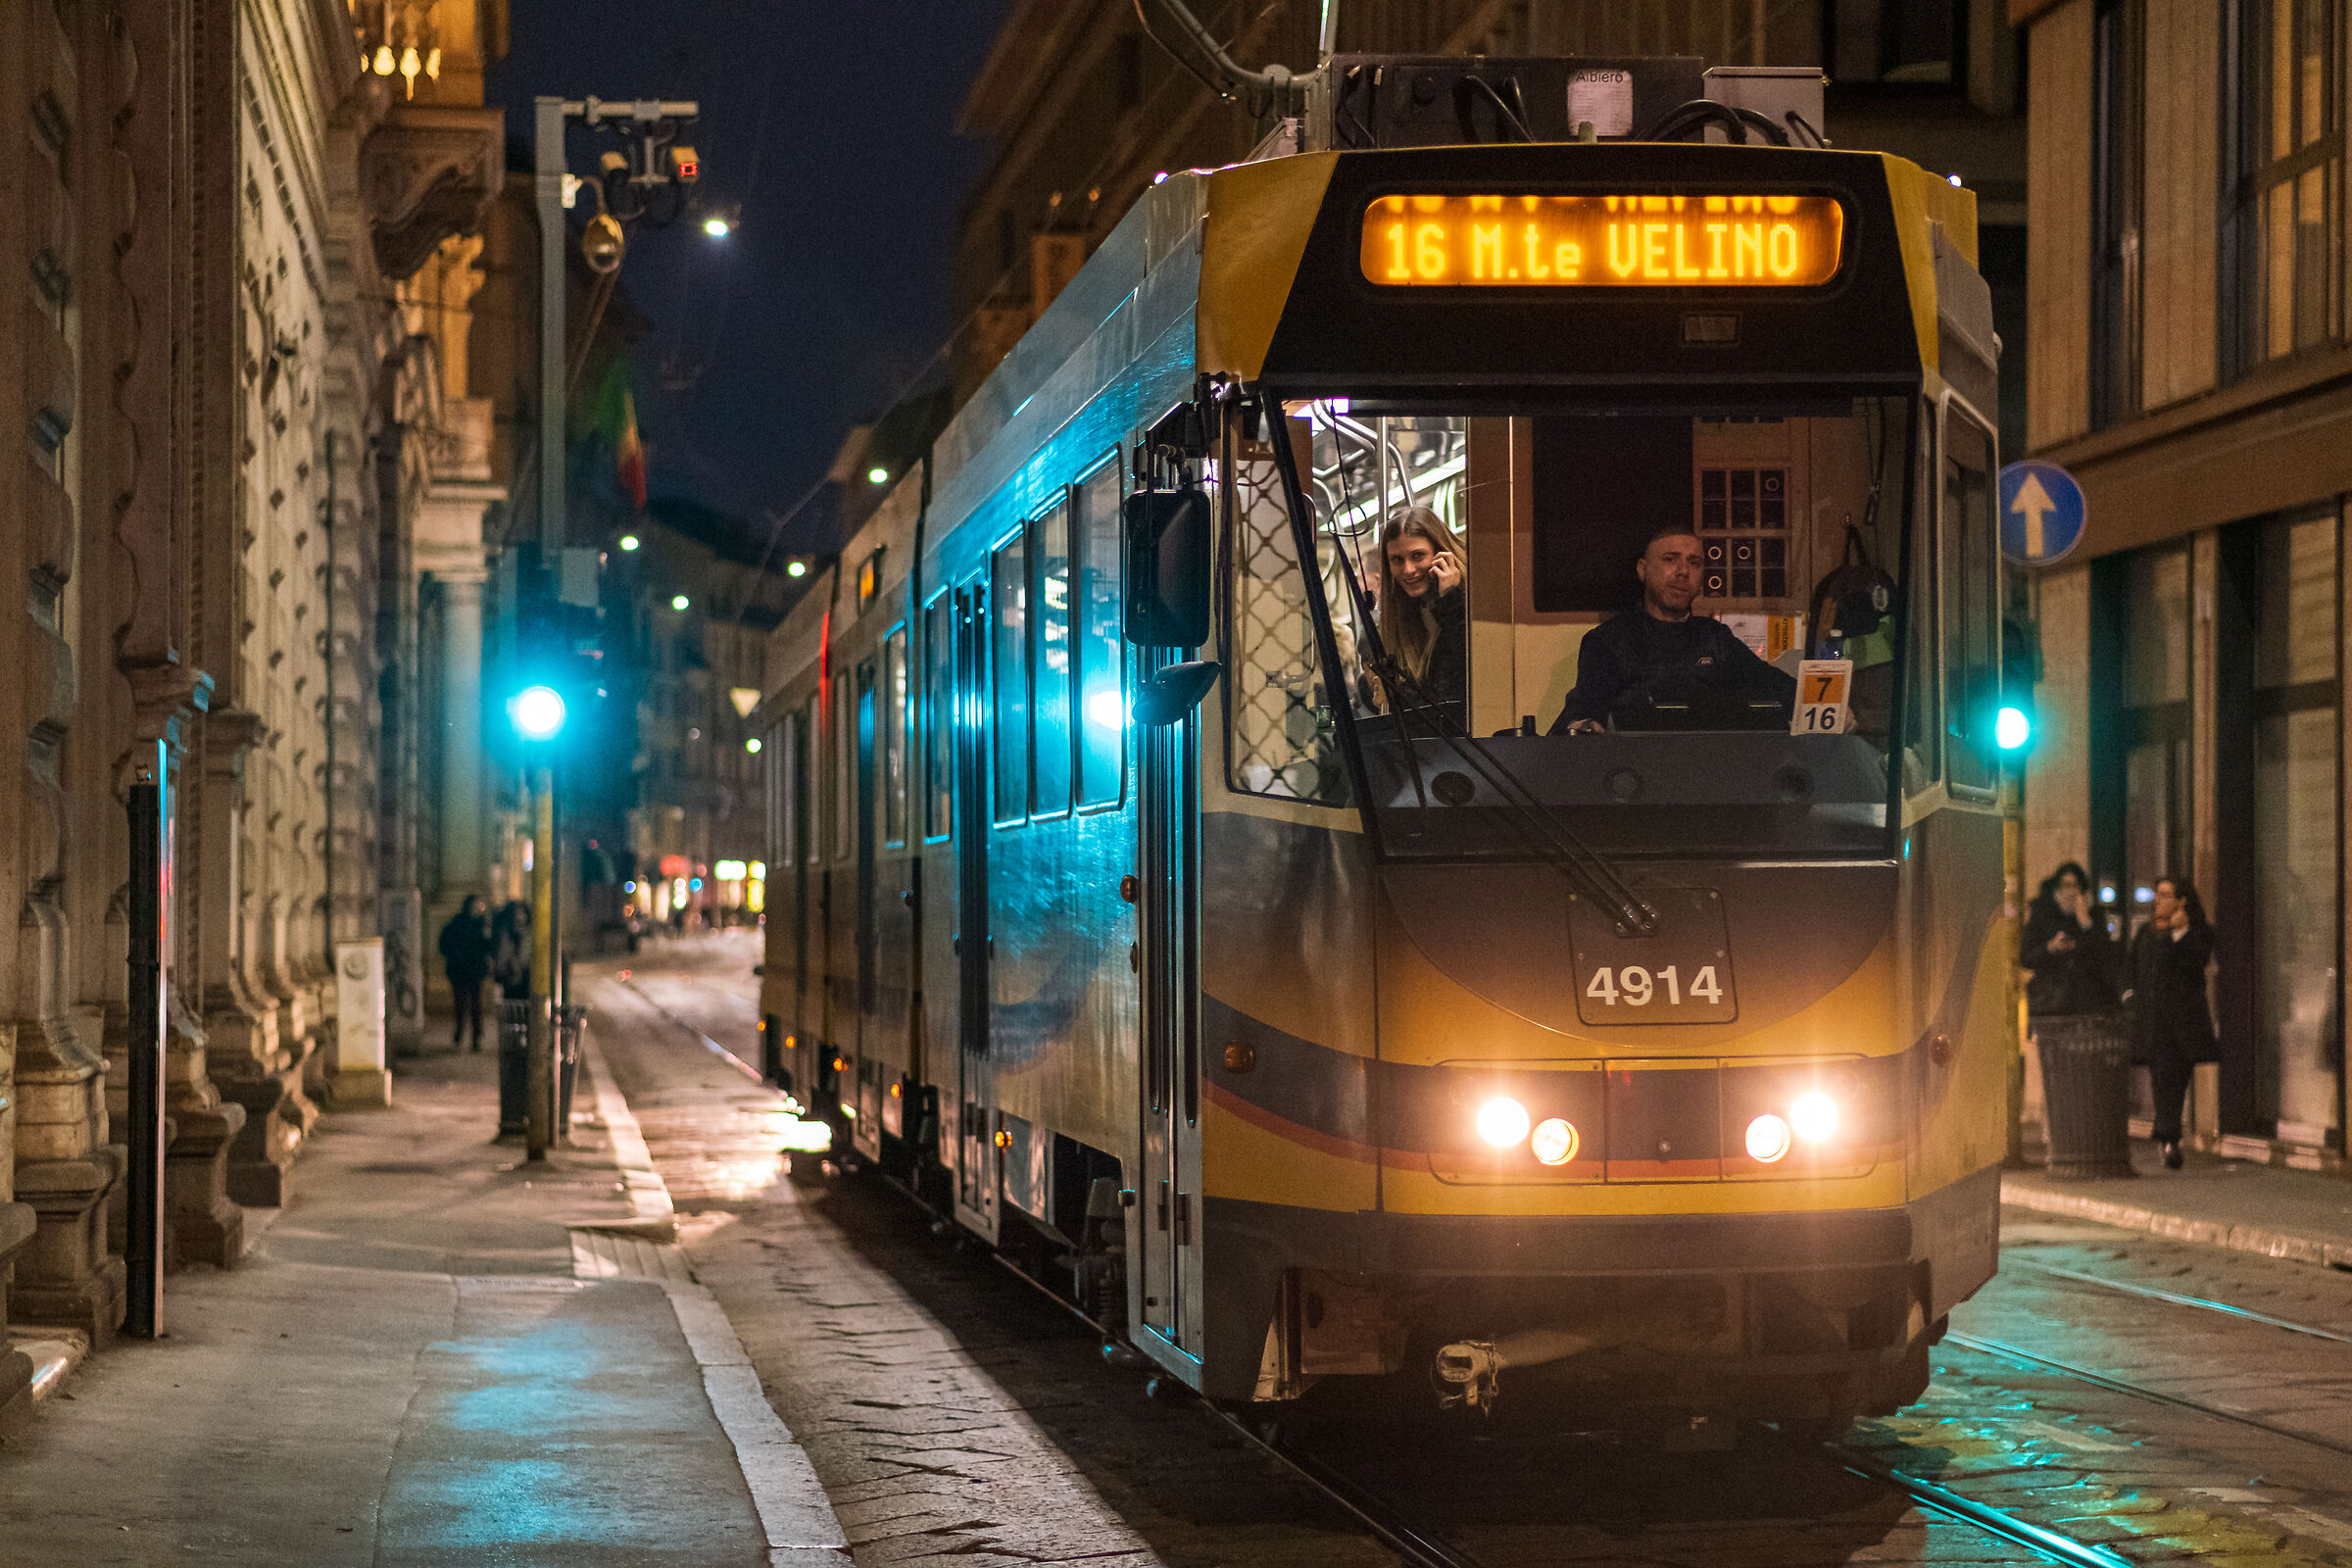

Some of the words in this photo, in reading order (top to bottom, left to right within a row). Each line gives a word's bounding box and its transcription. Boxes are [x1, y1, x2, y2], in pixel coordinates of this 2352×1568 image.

[1576, 70, 1623, 83] Albiero
[1388, 223, 1446, 278] 16
[1474, 223, 1581, 278] M.te
[1609, 223, 1797, 277] VELINO
[1817, 677, 1833, 702] 7
[1804, 707, 1837, 731] 16
[1586, 965, 1724, 1006] 4914
